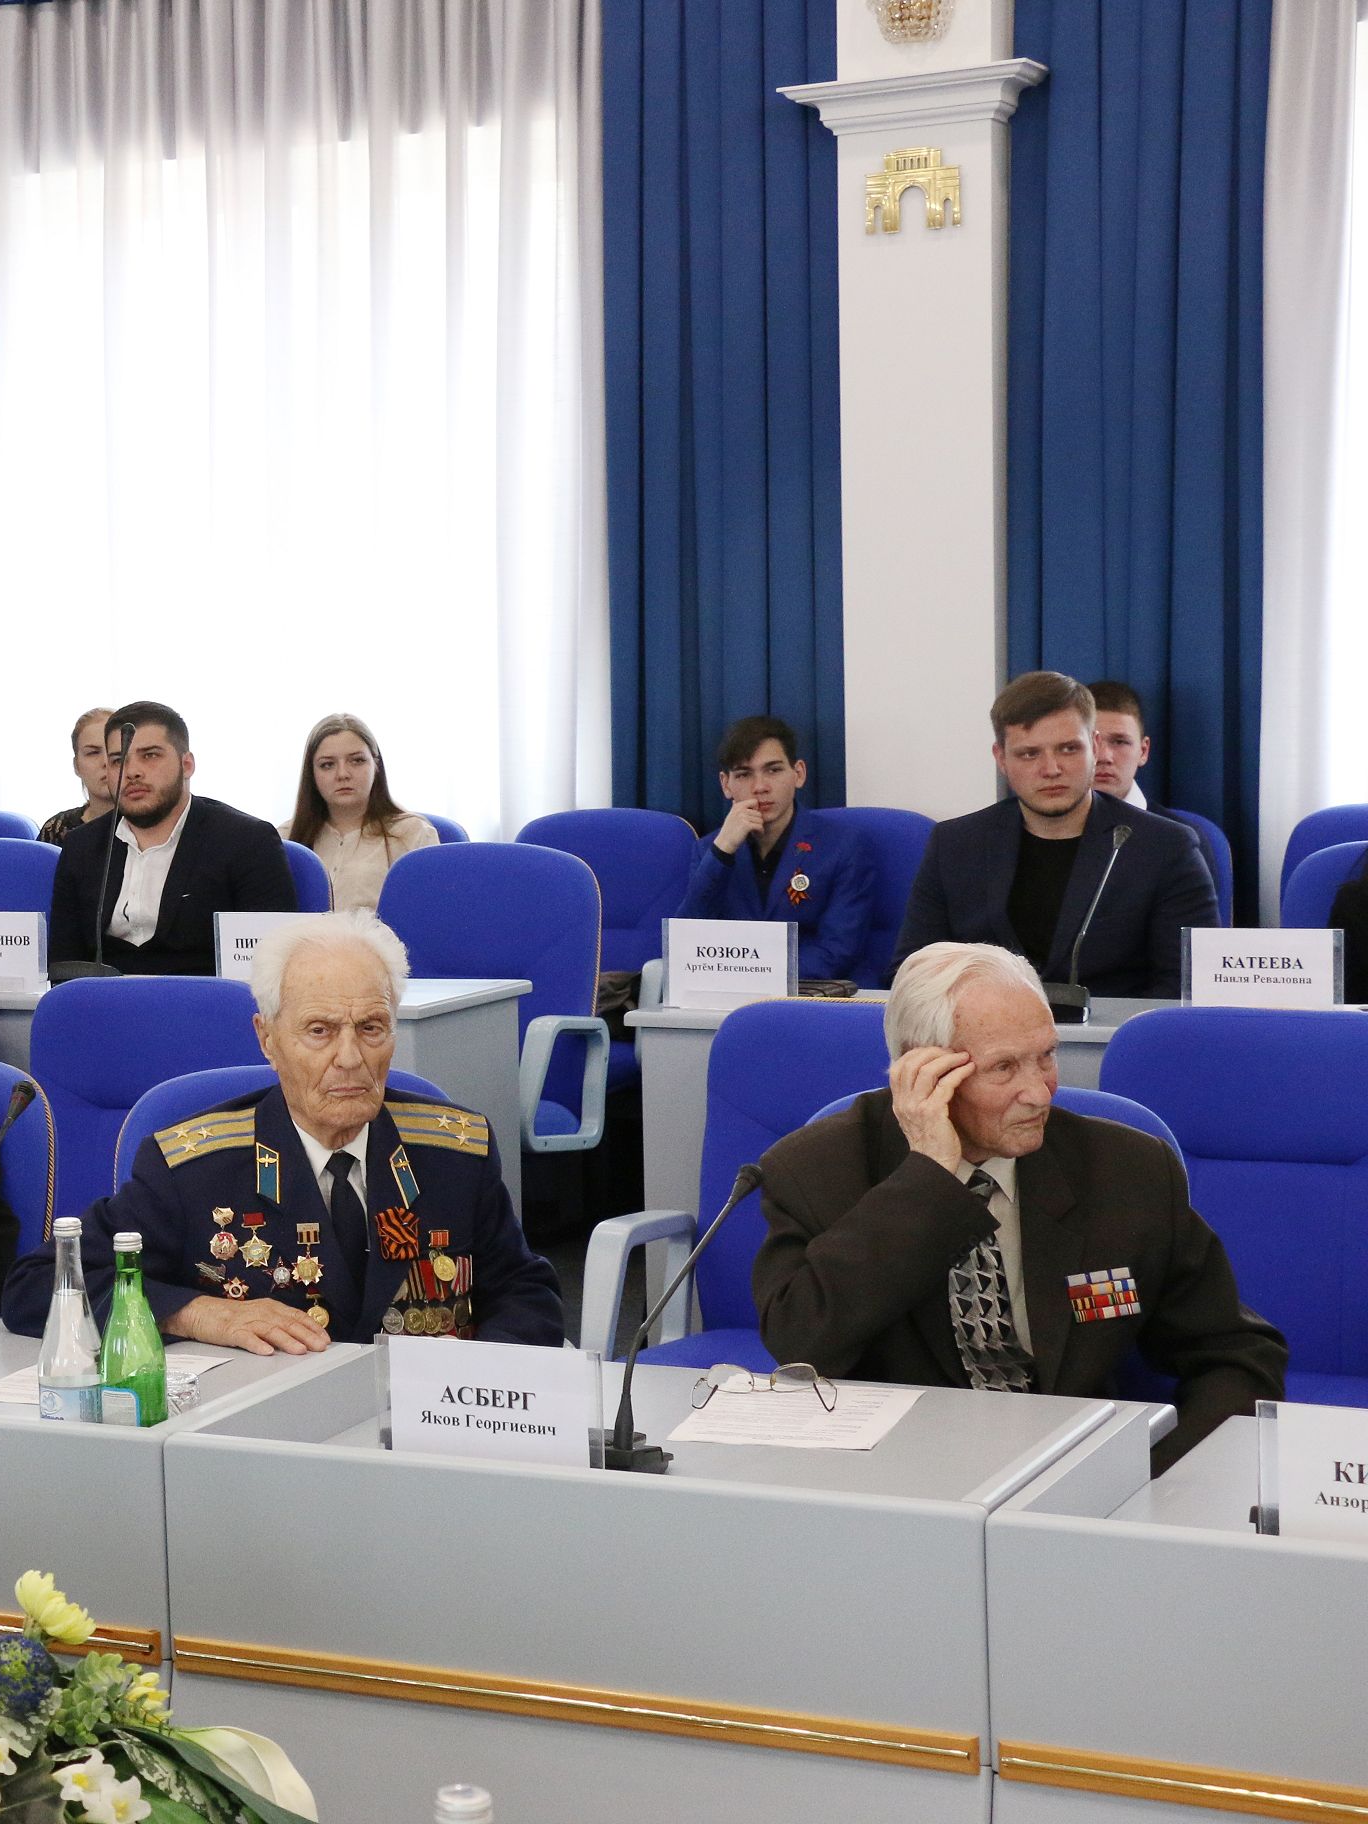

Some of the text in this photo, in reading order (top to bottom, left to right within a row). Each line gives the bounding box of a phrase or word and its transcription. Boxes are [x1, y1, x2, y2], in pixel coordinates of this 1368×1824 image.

[696, 946, 760, 960] КОЗЮРА
[684, 962, 772, 973] Артём Евгеньевич
[1221, 956, 1304, 970] КАТЕЕВА
[1213, 973, 1312, 985] Наиля Реваловна
[440, 1385, 537, 1411] АСБЕРГ
[420, 1410, 557, 1437] Яков Георгиевич
